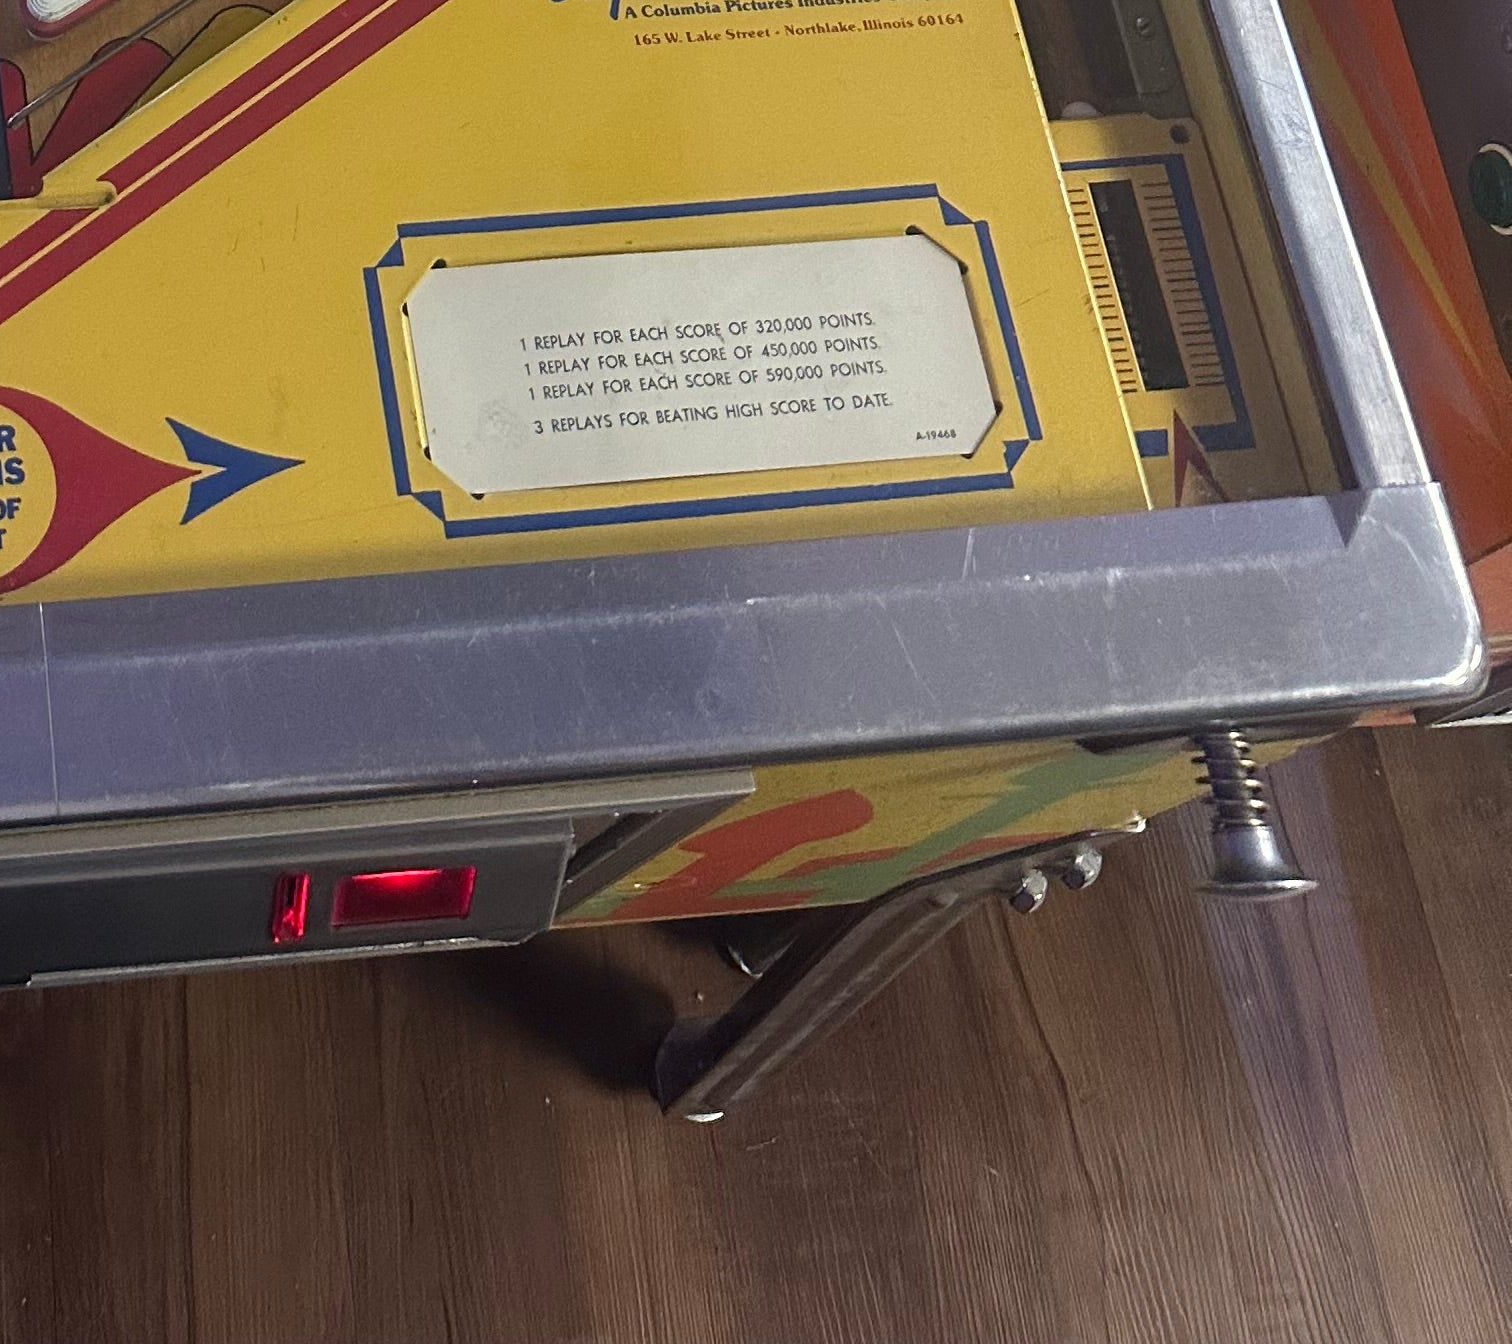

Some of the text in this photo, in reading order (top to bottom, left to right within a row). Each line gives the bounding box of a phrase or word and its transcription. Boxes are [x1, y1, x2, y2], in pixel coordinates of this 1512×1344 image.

[624, 6, 638, 20] A
[640, 0, 722, 19] Columbia
[723, 0, 794, 13] Pictures
[634, 13, 964, 46] 165 W. Lake Street Northlake, Illinois 60164
[519, 311, 876, 352] 1 REPLAY FOR EACH SCORE OF 320,000 POINTS.
